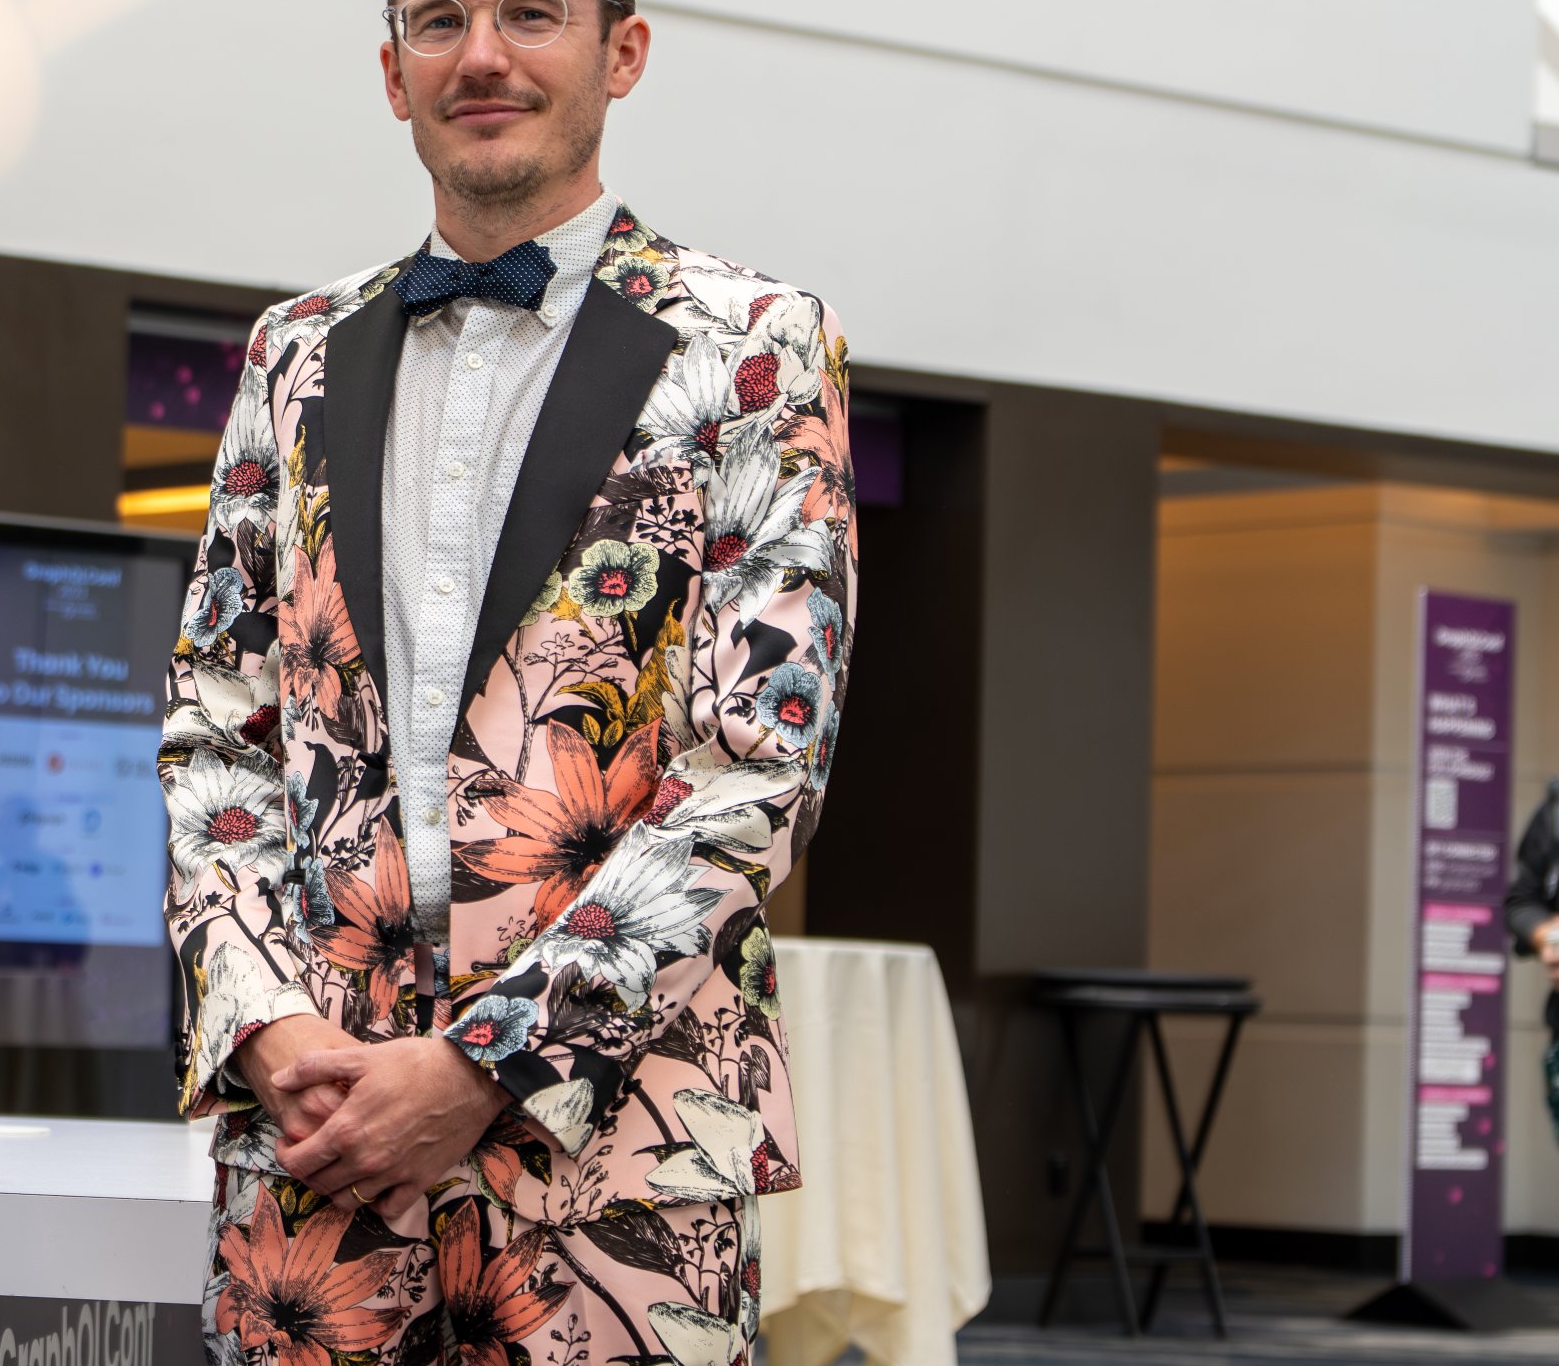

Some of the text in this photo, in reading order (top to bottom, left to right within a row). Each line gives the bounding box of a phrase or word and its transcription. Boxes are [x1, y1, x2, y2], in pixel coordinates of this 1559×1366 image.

[13, 646, 129, 682] Thank You
[13, 681, 50, 708] Our
[54, 687, 155, 715] Sponsors
